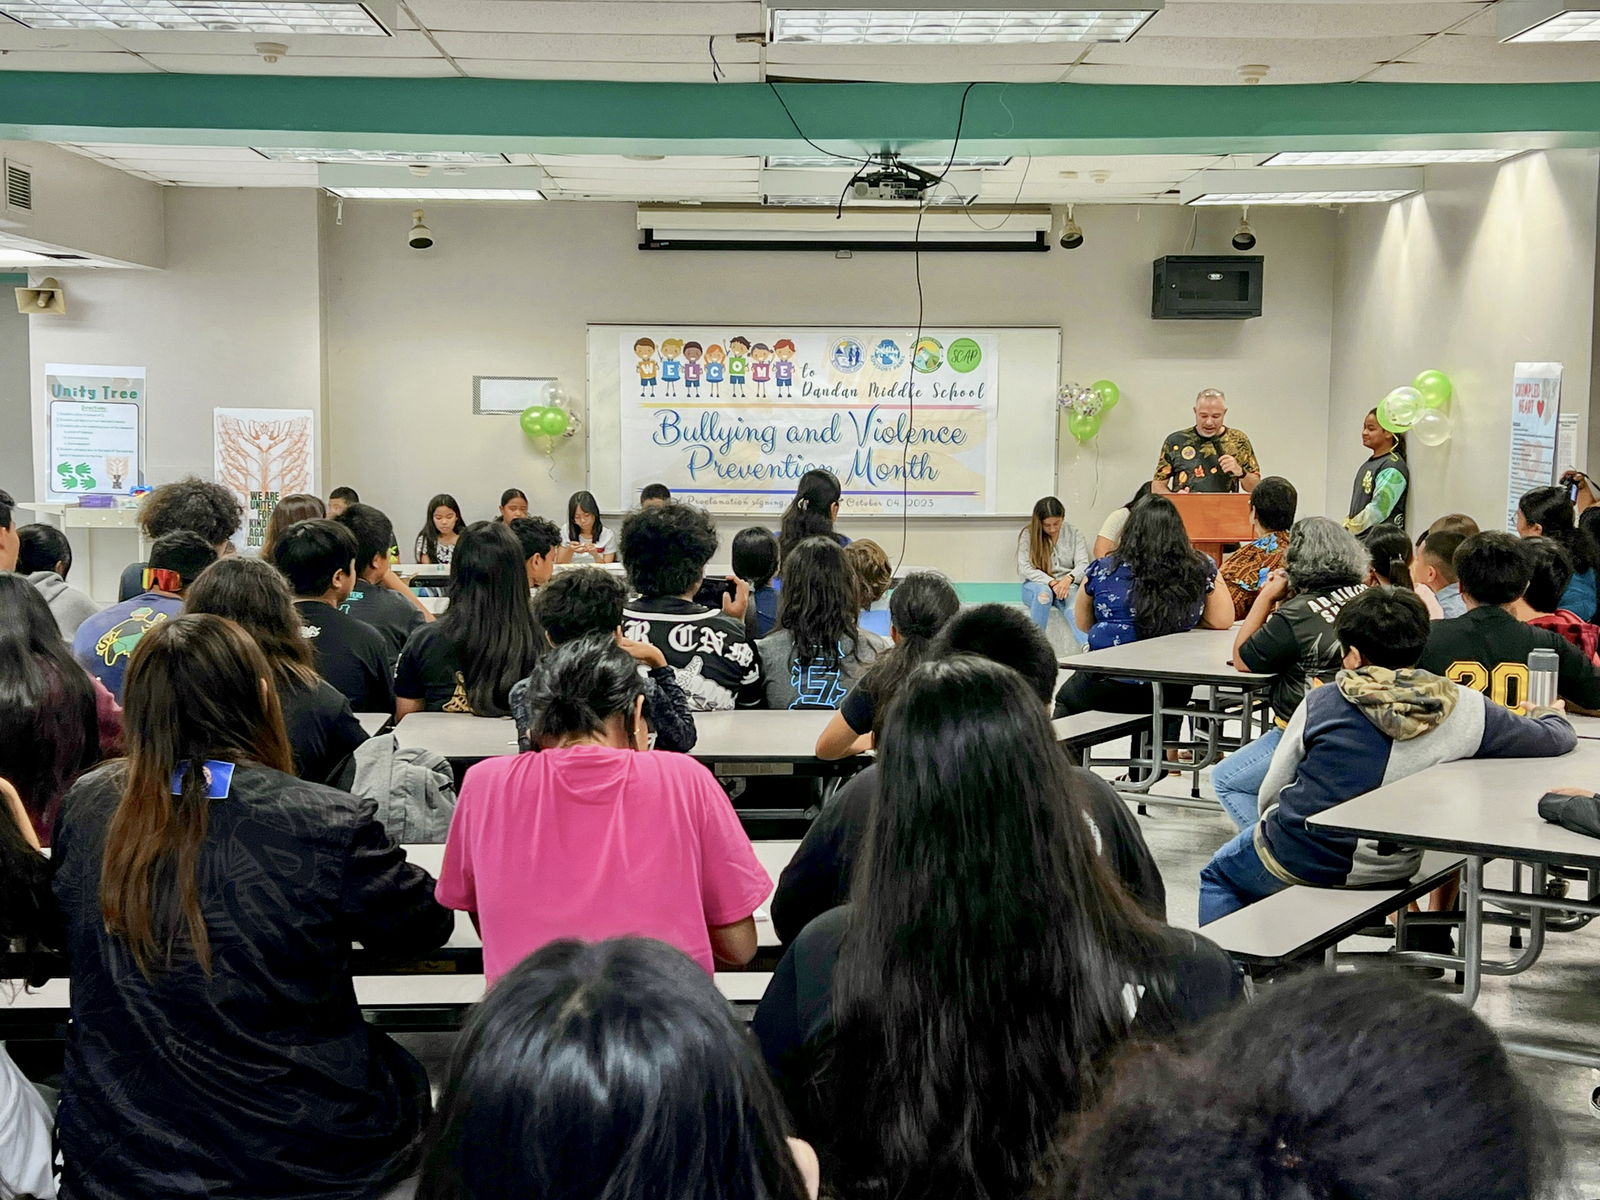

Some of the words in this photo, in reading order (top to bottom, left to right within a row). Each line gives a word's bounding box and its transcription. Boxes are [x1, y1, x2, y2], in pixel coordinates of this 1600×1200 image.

[952, 349, 979, 364] SCAP
[640, 362, 790, 379] WELCOME
[51, 384, 97, 401] Unity
[102, 386, 138, 400] Tree
[801, 381, 858, 398] Dandan
[868, 382, 922, 399] Middle
[932, 381, 985, 401] School
[652, 408, 777, 455] Bullying
[786, 412, 843, 445] and
[848, 404, 968, 448] Violence
[844, 446, 940, 488] Month
[250, 491, 263, 501] WE
[264, 491, 280, 501] ARE
[687, 495, 749, 506] Proclamation
[250, 500, 278, 510] UNITED
[1445, 661, 1529, 717] 20
